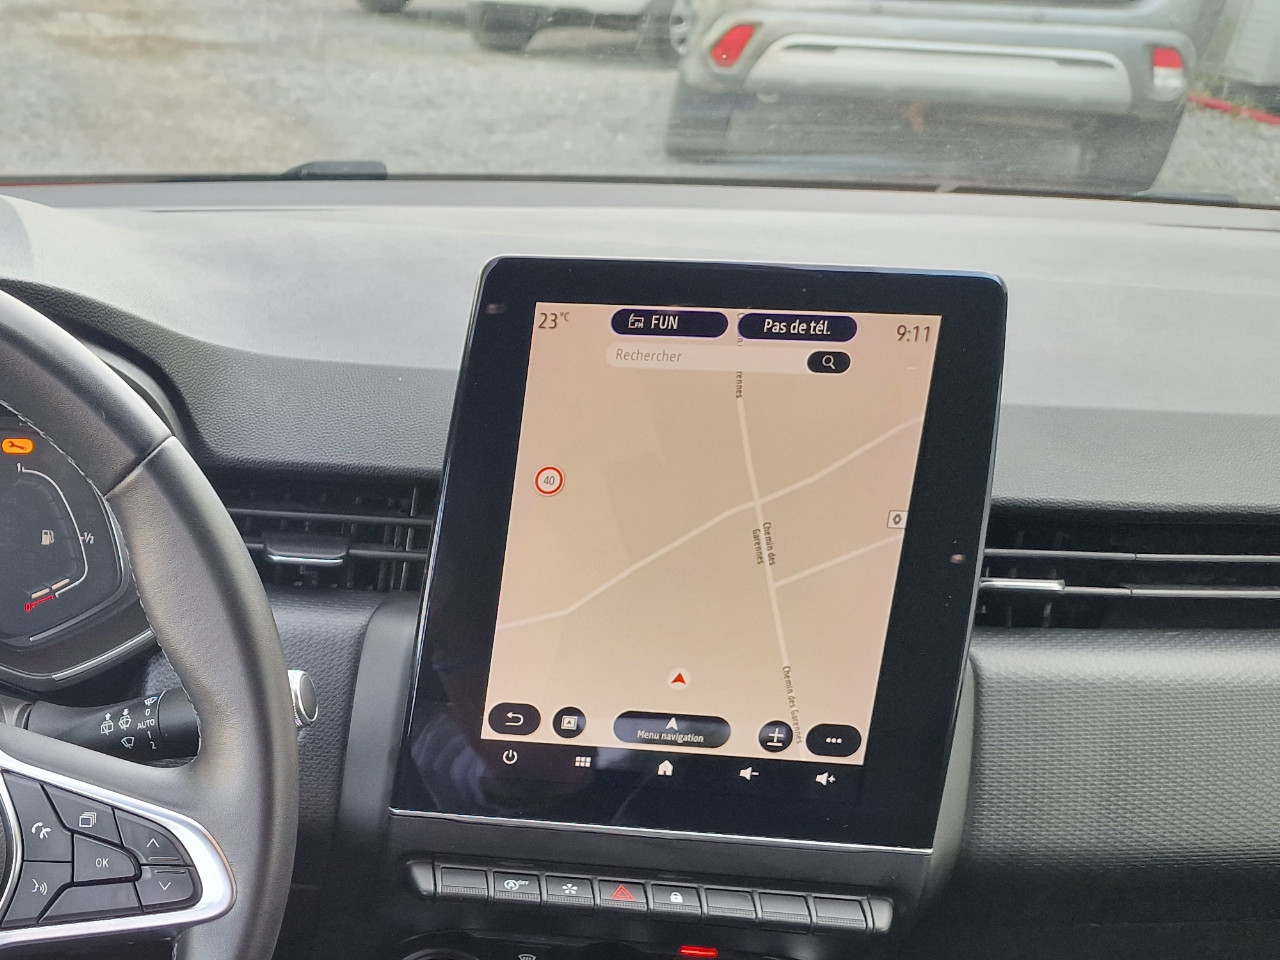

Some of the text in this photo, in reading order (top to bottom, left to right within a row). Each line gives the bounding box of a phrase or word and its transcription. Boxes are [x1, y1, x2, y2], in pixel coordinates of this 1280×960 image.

[650, 315, 679, 330] FUN
[763, 318, 787, 334] Pas
[790, 321, 807, 335] de
[809, 319, 831, 335] tél.
[896, 324, 931, 342] 9:11
[615, 347, 682, 363] Rechercher
[735, 370, 743, 399] rennes
[16, 462, 21, 472] 1
[543, 475, 555, 486] 40
[752, 528, 764, 565] Garennes
[763, 522, 776, 566] Chemin des
[25, 603, 31, 612] 0
[782, 666, 802, 744] Chemin des Garennes
[137, 718, 156, 730] AUTO
[147, 730, 152, 739] 1
[637, 730, 704, 744] Menu navigation
[150, 741, 157, 750] 2
[95, 857, 109, 869] OK
